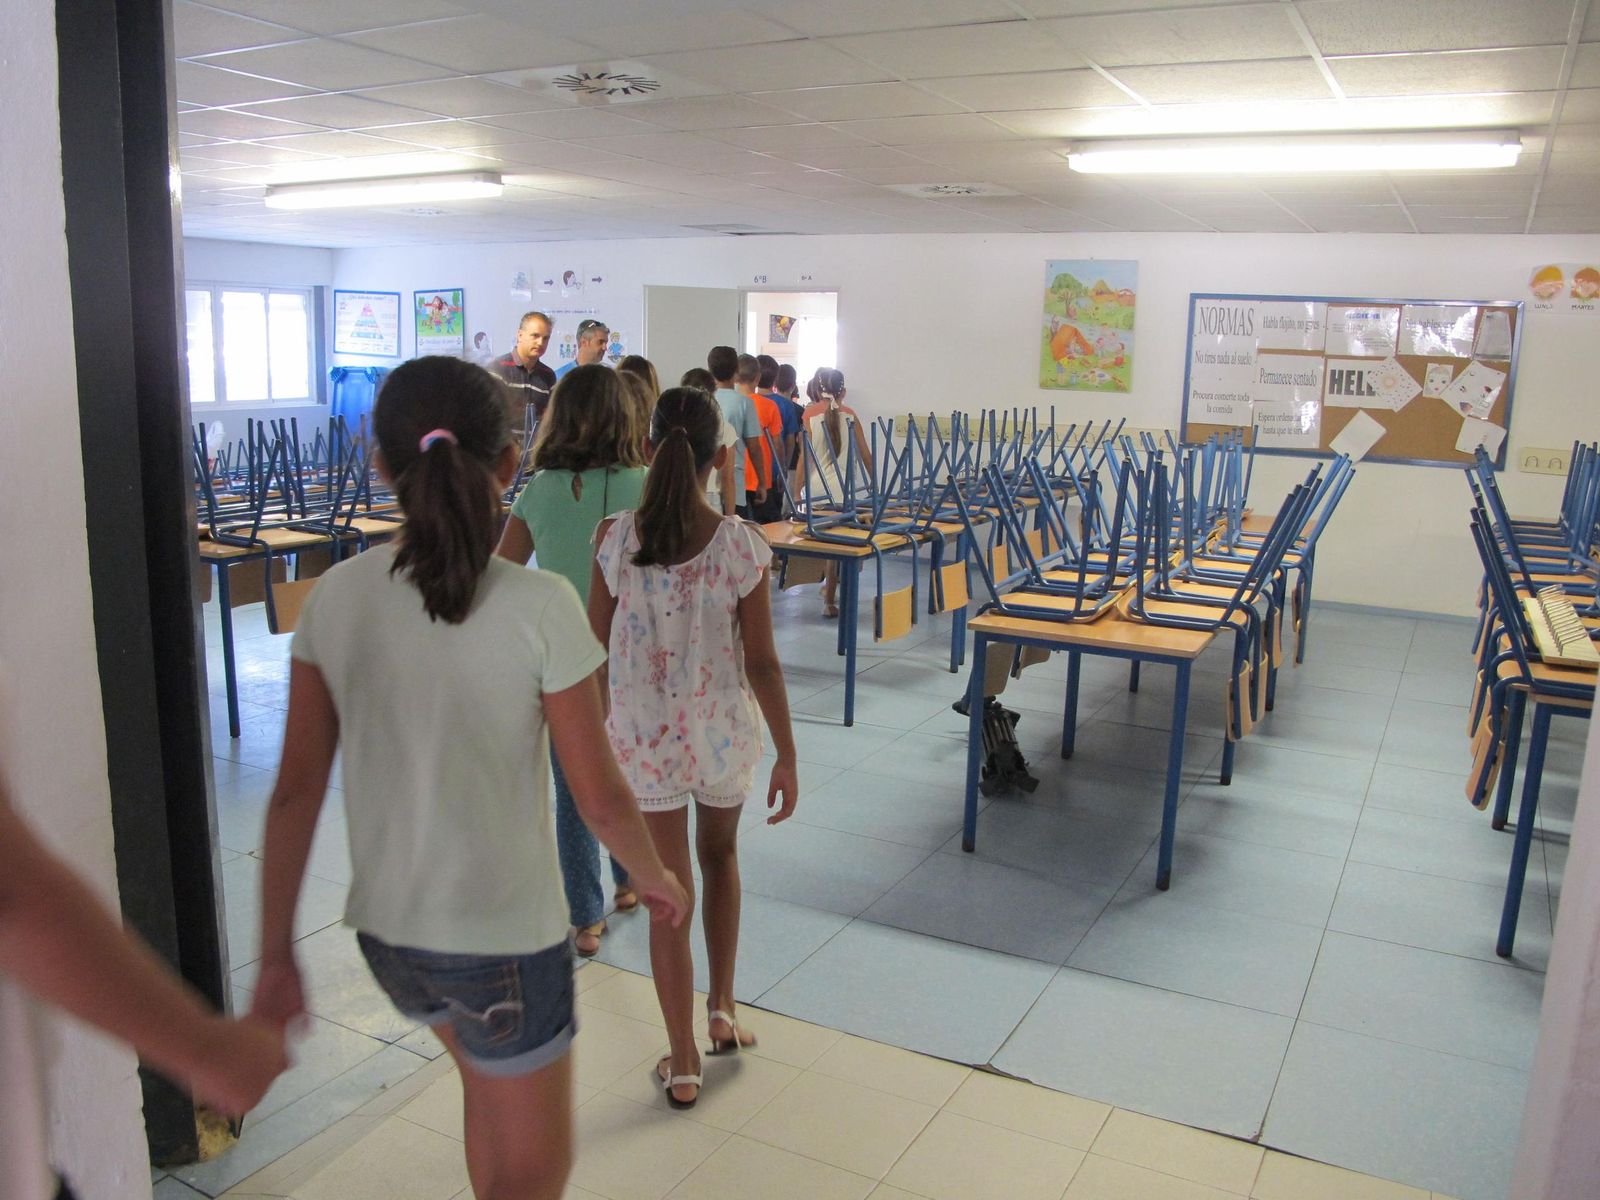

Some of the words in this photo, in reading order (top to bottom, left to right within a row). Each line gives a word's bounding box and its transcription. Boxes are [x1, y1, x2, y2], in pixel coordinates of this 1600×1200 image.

[1199, 306, 1255, 336] NORMAS
[1297, 320, 1305, 330] no
[1195, 350, 1203, 364] No
[1217, 352, 1230, 365] nada
[1238, 352, 1252, 366] suelo
[1259, 368, 1293, 385] Permanece
[1293, 370, 1318, 387] sentado
[1193, 390, 1214, 400] Procura
[1215, 392, 1237, 401] comerte
[1238, 392, 1250, 402] toda
[1206, 403, 1212, 413] la
[1213, 404, 1233, 414] comida
[1258, 412, 1275, 422] Espera
[1263, 425, 1276, 434] hasta
[1277, 427, 1287, 437] que
[1288, 426, 1293, 434] te
